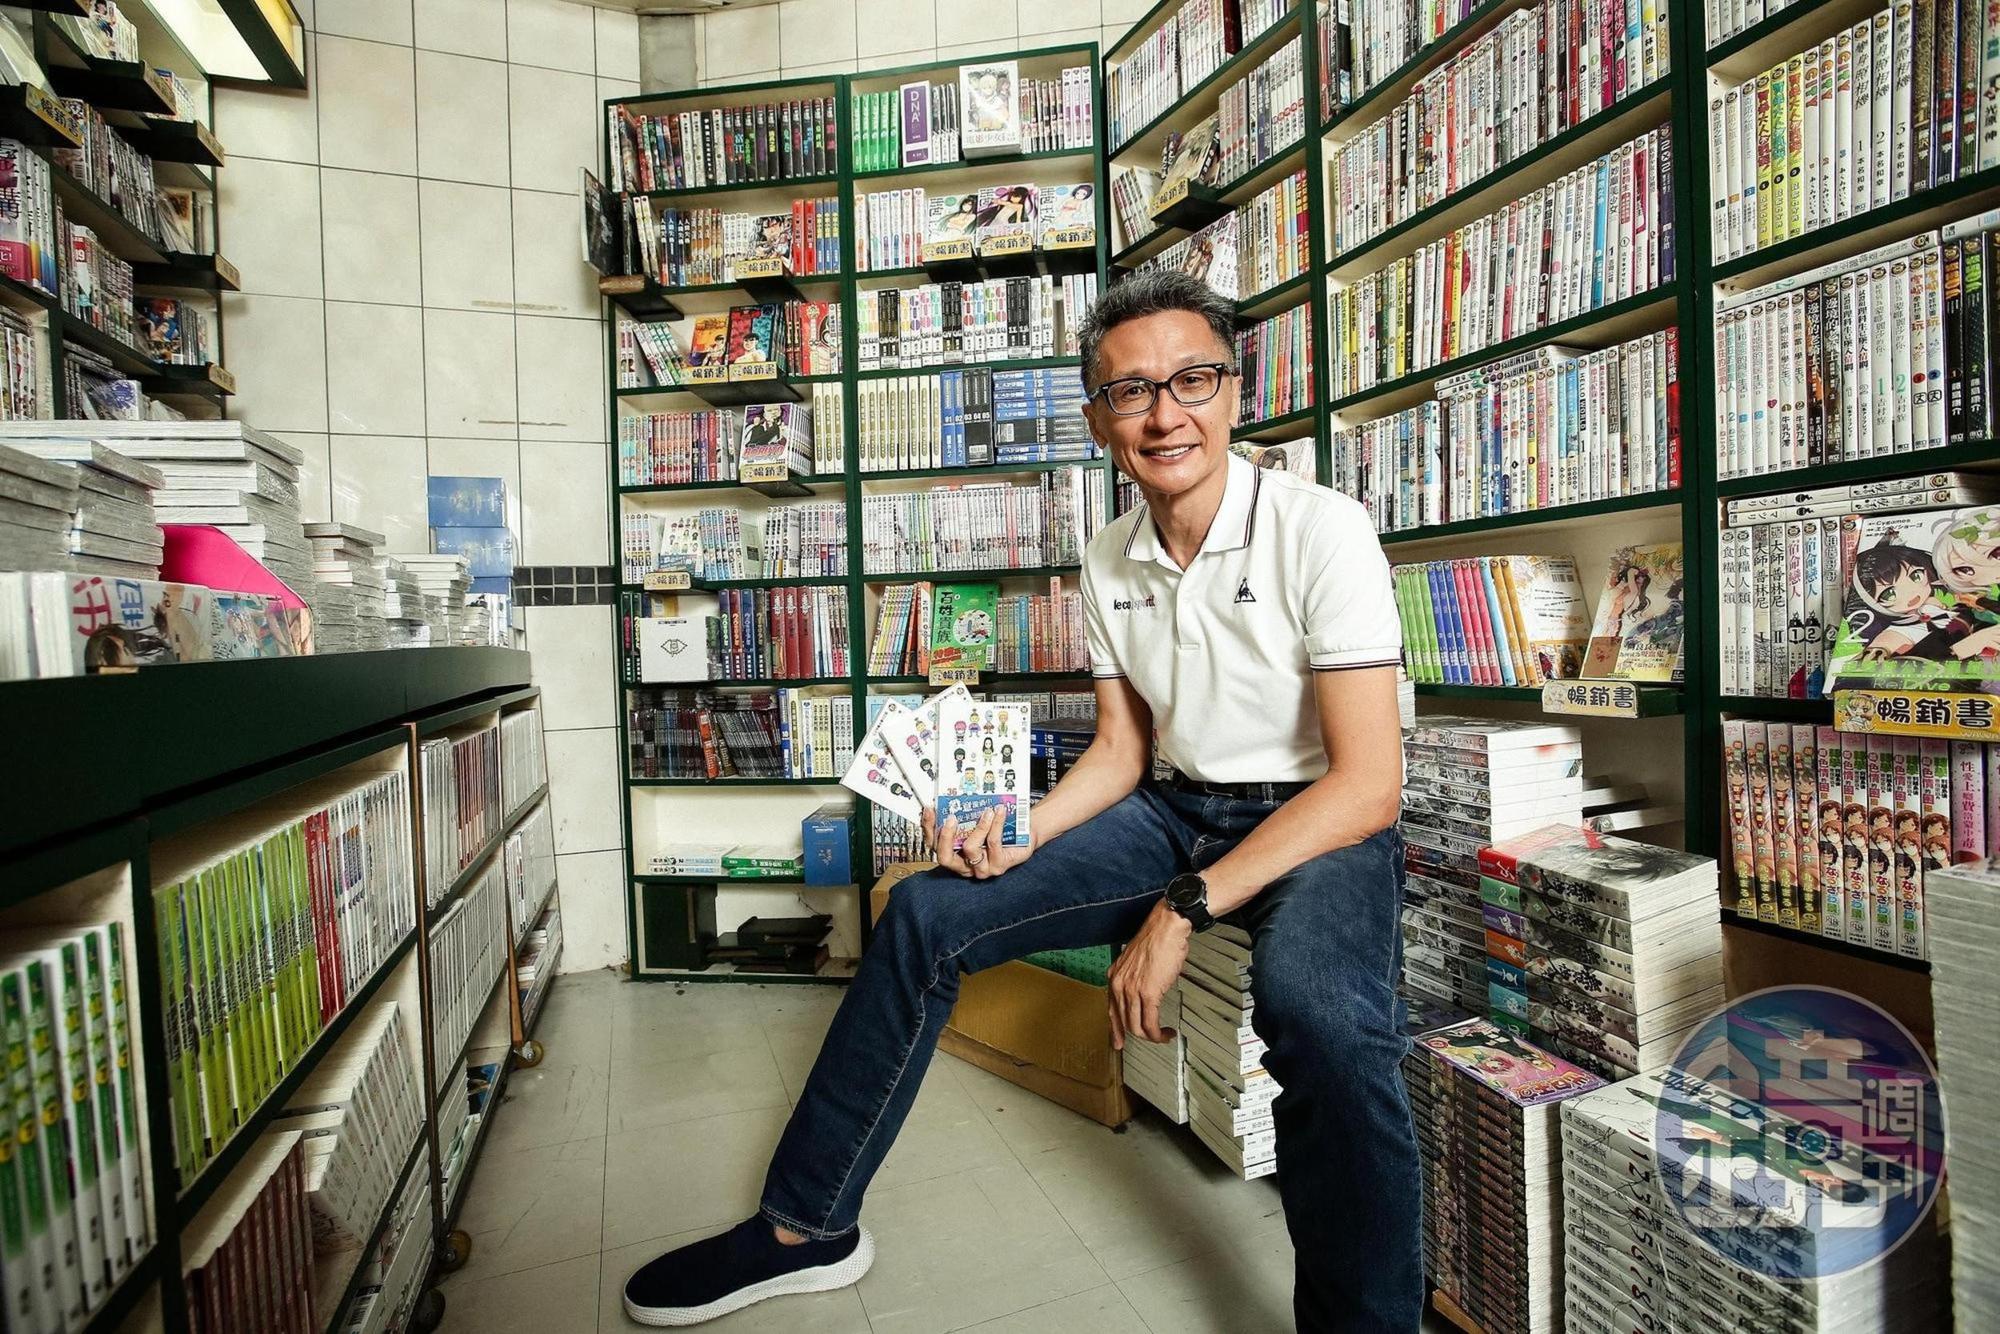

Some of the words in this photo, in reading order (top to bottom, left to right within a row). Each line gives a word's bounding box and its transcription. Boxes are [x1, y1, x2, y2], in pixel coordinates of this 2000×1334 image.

[994, 236, 1030, 249] 暢銷書
[1055, 230, 1093, 243] 暢銷書
[935, 242, 971, 255] 暢銷書
[692, 366, 725, 379] 暢銷書
[742, 363, 775, 375] 暢銷書
[1896, 374, 1906, 392] 2
[1723, 545, 1737, 605] 食糧人類
[1738, 544, 1751, 605] 食糧人類
[937, 592, 954, 643] 百姓貴族
[1807, 628, 1815, 639] 2
[1842, 610, 1875, 643] 2
[942, 669, 978, 681] 暢銷書
[1567, 685, 1634, 708] 暢銷書
[1877, 697, 1994, 728] 暢銷書
